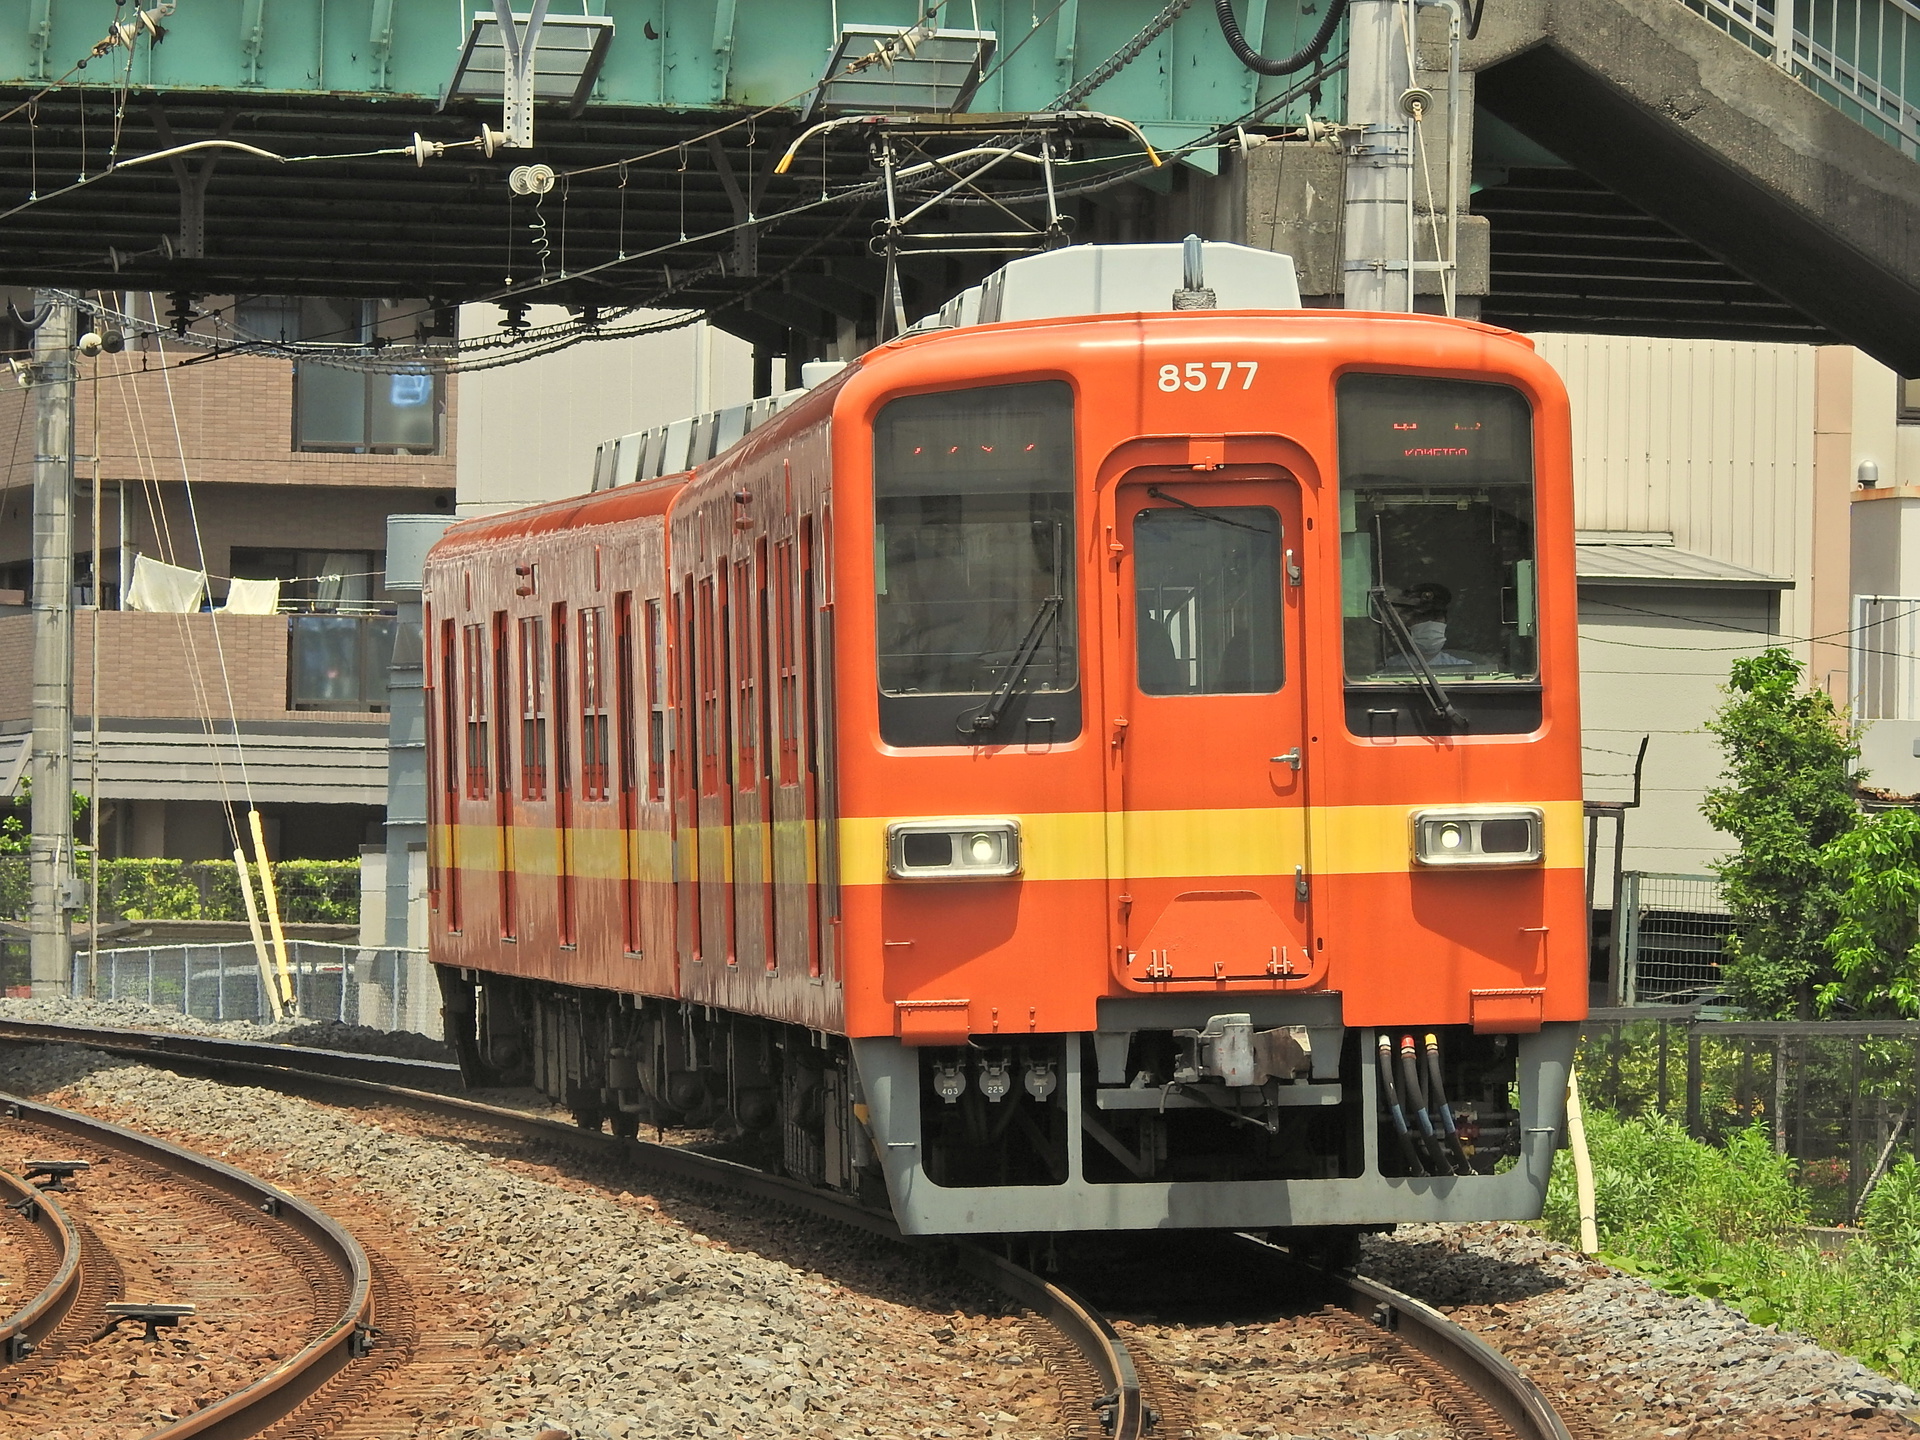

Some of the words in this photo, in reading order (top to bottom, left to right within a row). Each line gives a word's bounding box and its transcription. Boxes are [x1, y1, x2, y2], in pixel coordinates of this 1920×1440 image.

[1158, 361, 1259, 392] 8577
[942, 1087, 959, 1095] 403
[987, 1086, 1004, 1094] 225
